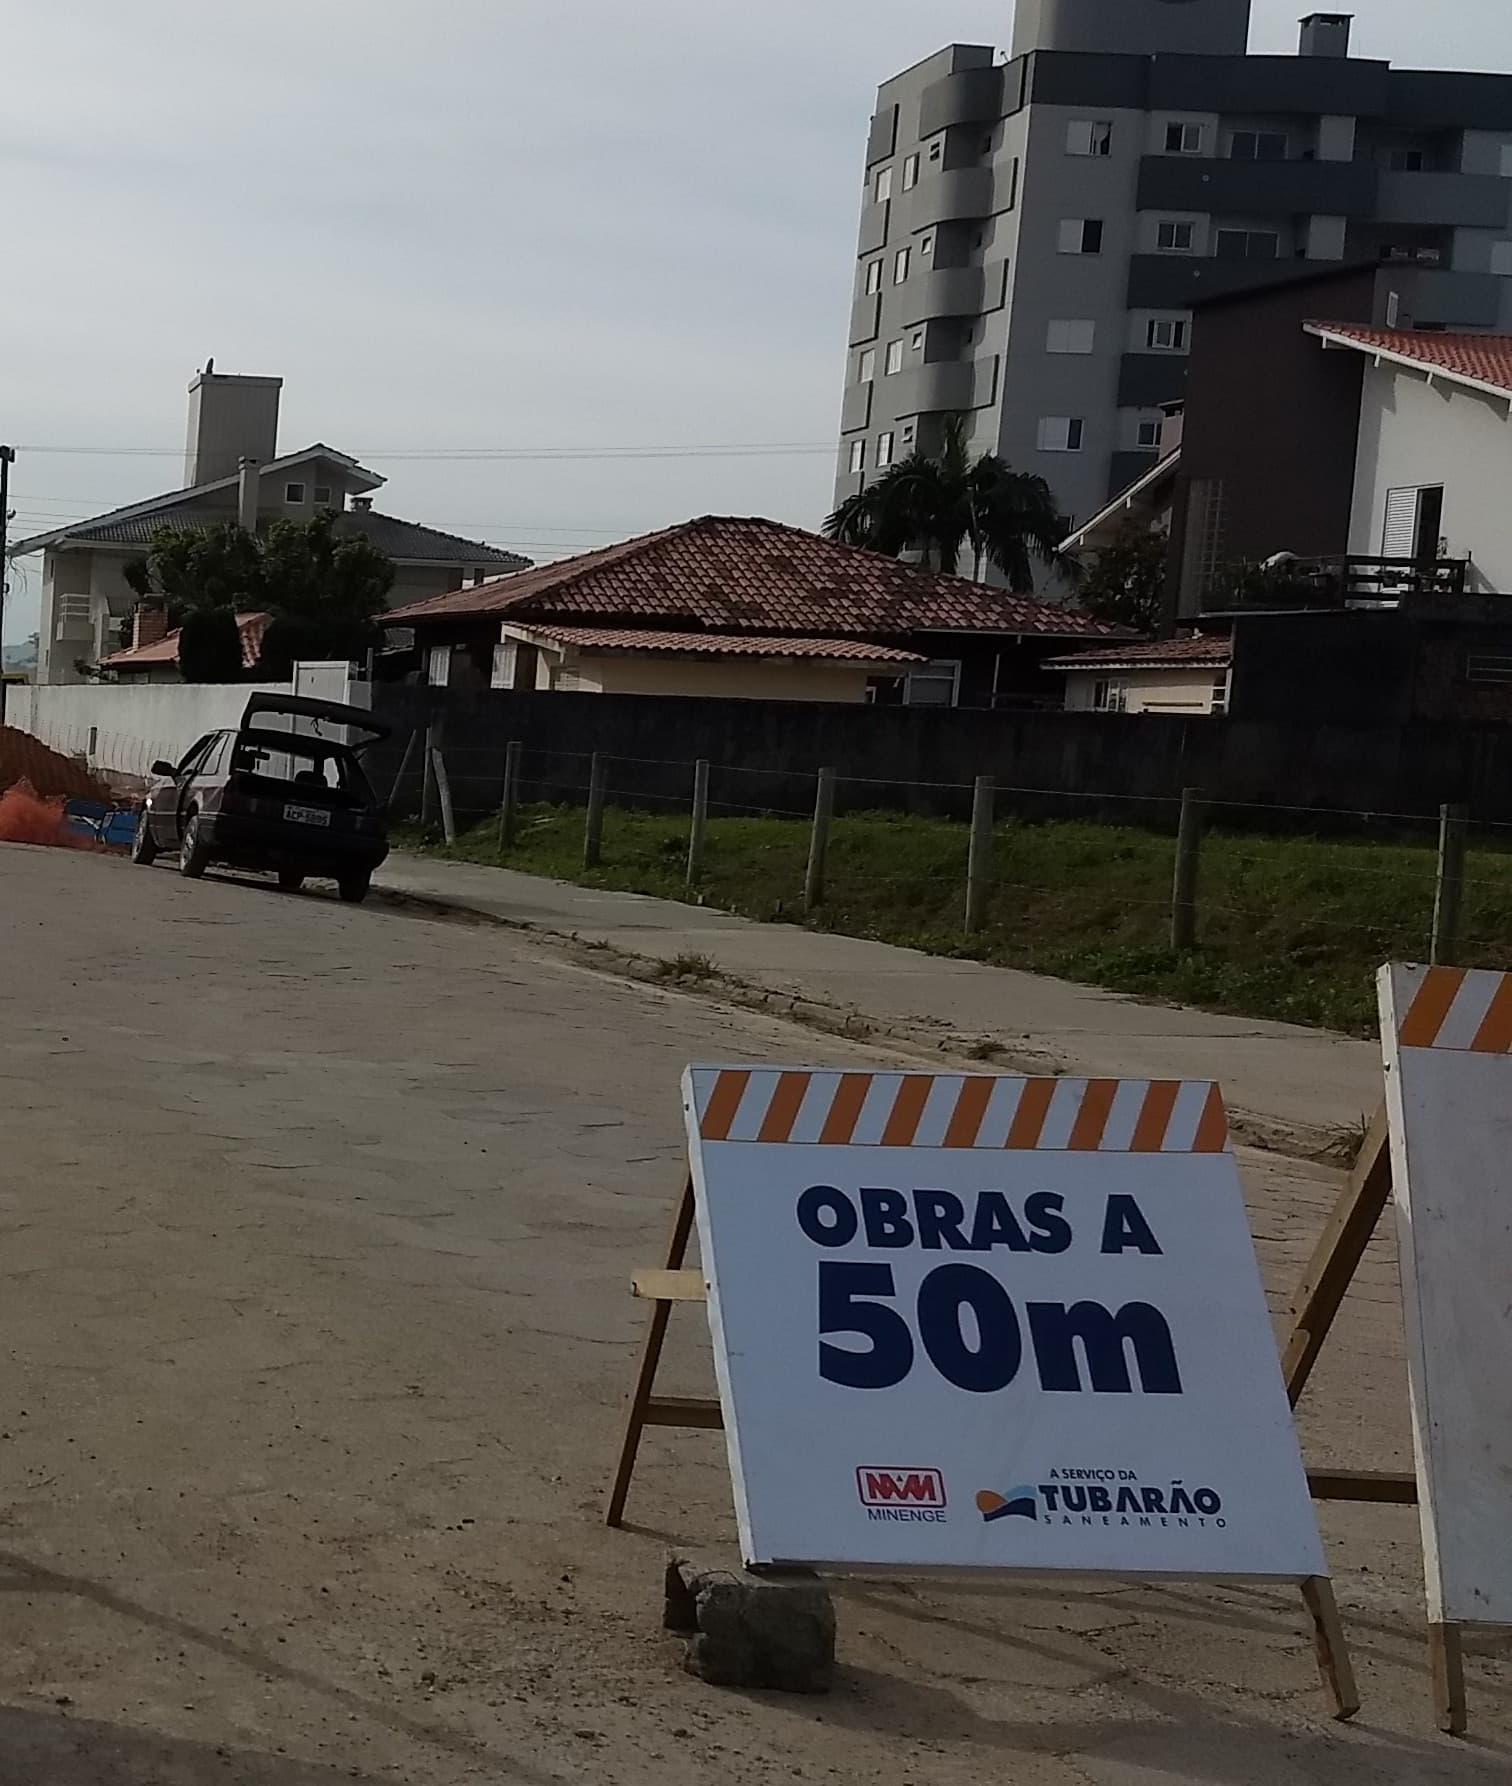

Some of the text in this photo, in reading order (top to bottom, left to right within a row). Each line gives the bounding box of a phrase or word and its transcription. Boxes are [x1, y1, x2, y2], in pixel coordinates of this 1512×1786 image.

[796, 1185, 1164, 1255] OBRAS A
[818, 1260, 1183, 1394] 50m
[1049, 1468, 1137, 1482] A SERVIÇO DA
[1038, 1480, 1221, 1515] TUBARÃO
[867, 1508, 947, 1523] MINENGE
[1044, 1515, 1226, 1528] SANEAMENTO
